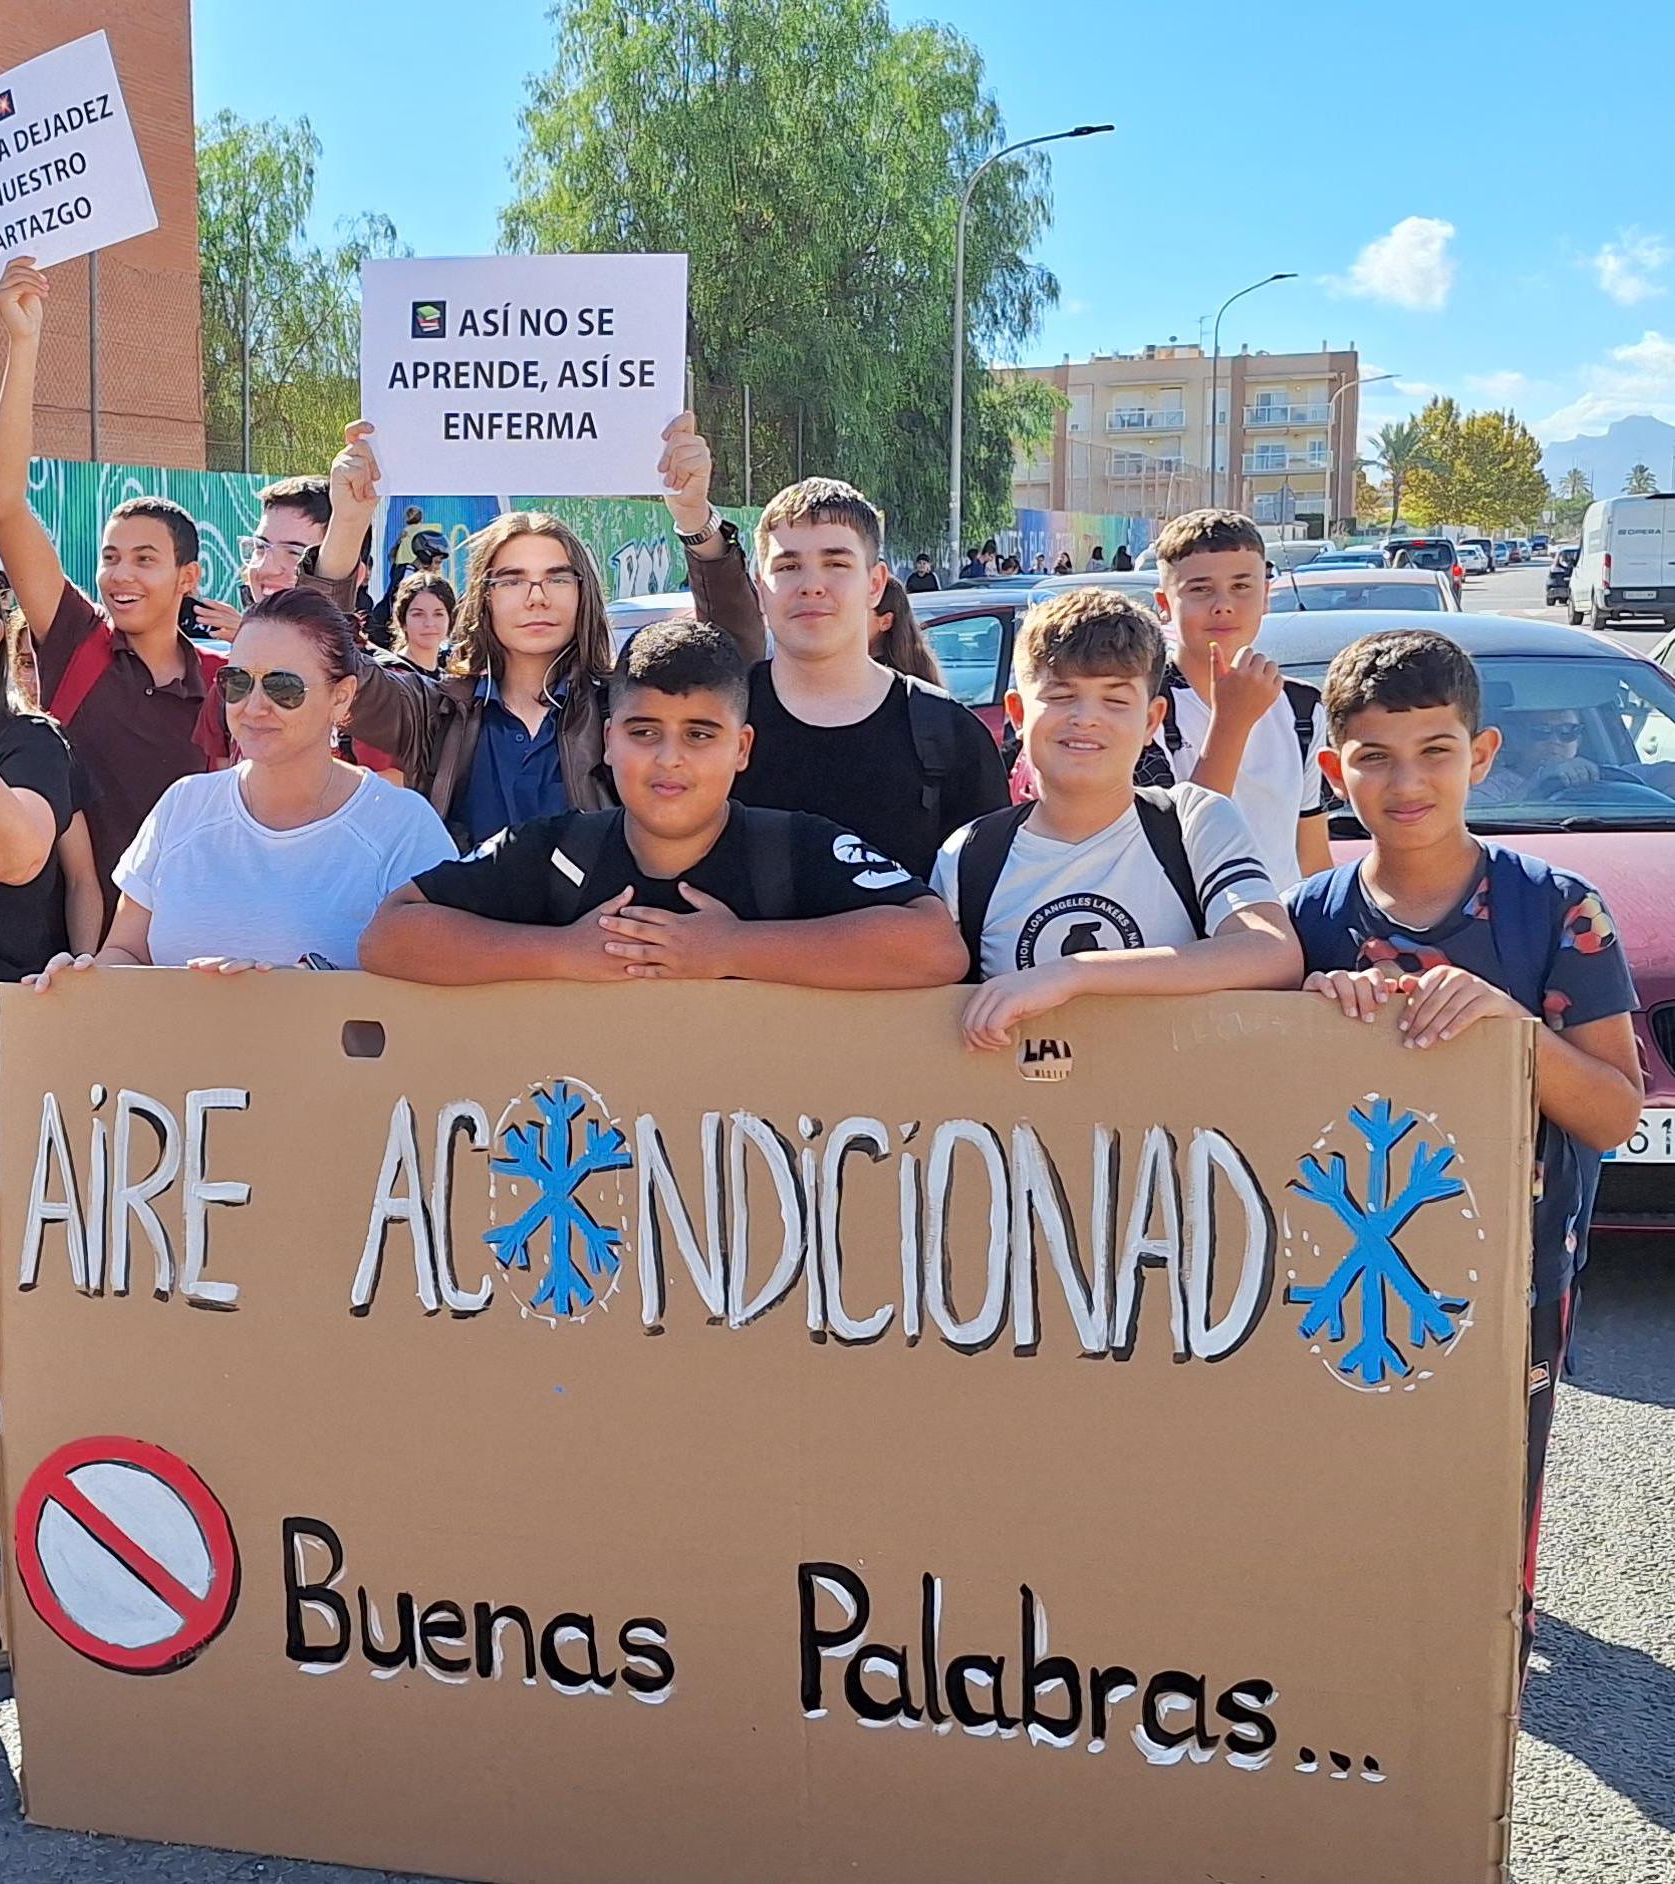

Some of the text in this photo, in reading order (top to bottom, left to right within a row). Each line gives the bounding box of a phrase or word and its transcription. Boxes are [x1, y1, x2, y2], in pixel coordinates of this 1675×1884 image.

[13, 94, 114, 153] DEJADEZ
[458, 302, 614, 337] ASÍ NO SE
[387, 354, 656, 393] APRENDE, ASÍ SE
[443, 411, 598, 440] ENFERMA
[1027, 913, 1044, 933] LOS
[1043, 897, 1092, 917] ANGELES
[1092, 898, 1131, 928] LAKERS
[282, 1515, 677, 1705] Buenas
[797, 1561, 1388, 1783] Palabras...
